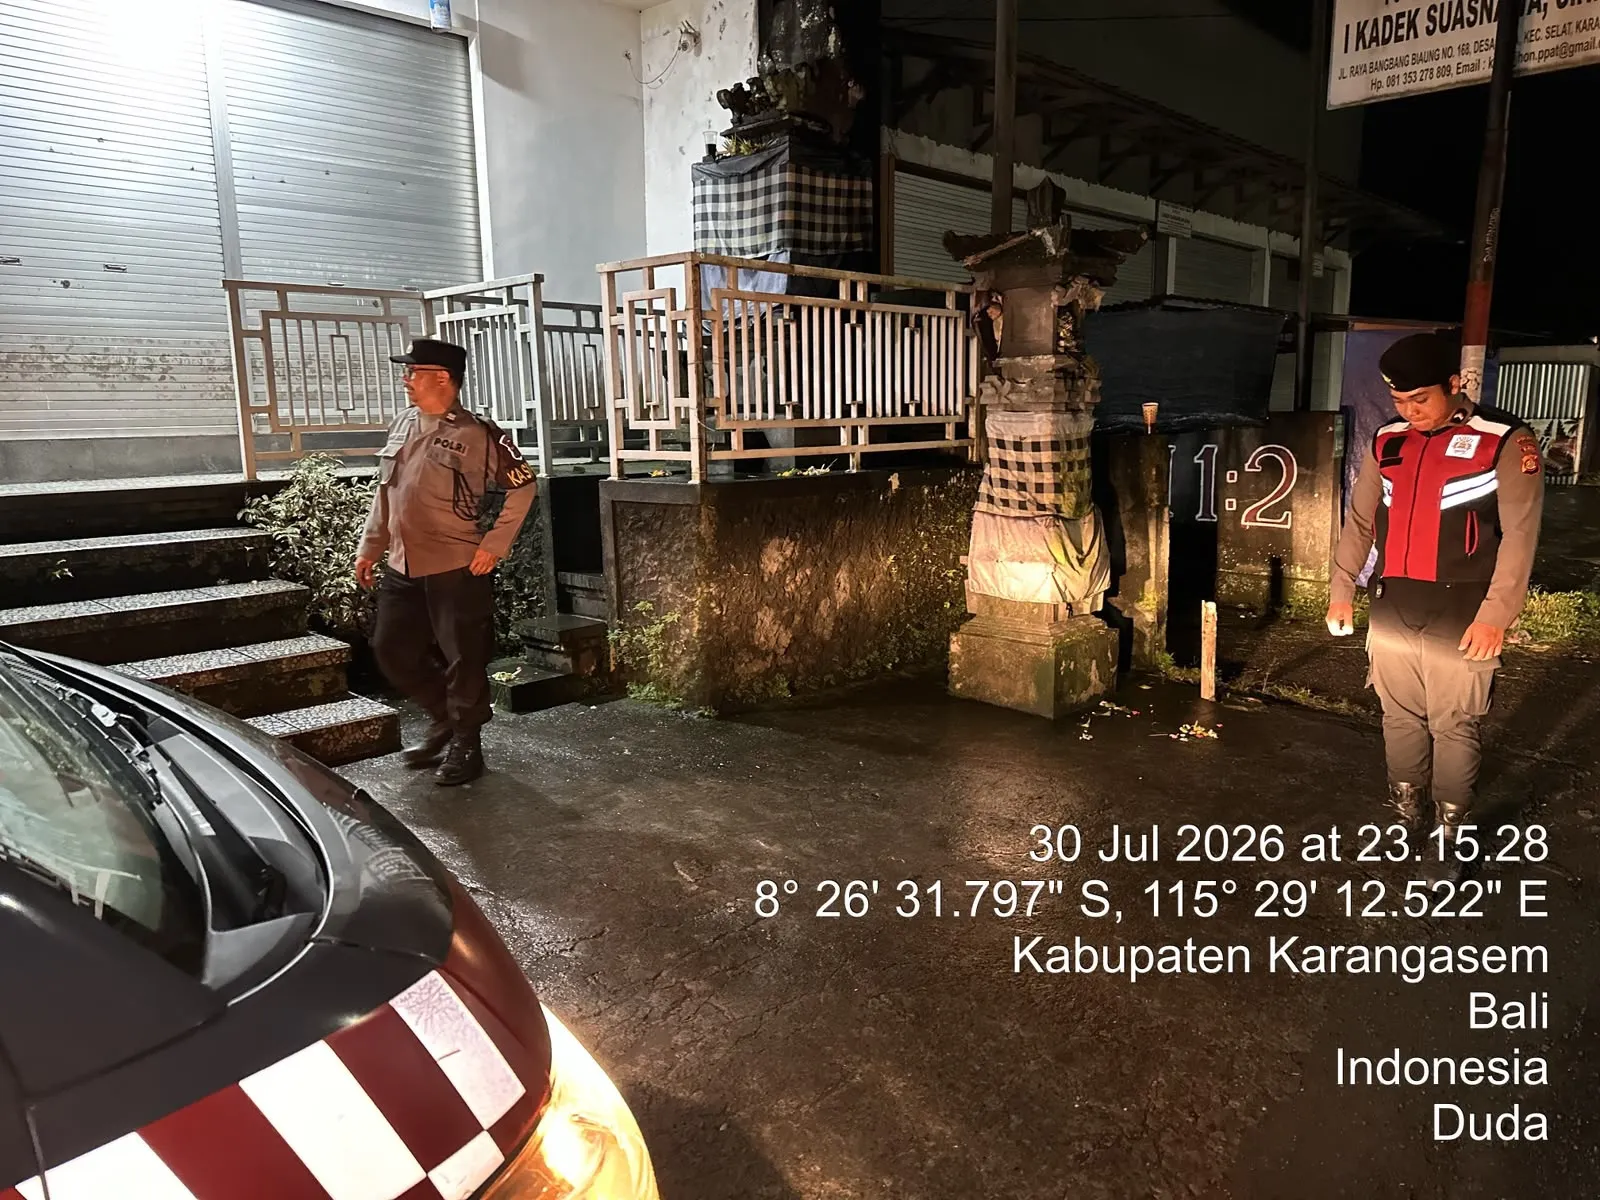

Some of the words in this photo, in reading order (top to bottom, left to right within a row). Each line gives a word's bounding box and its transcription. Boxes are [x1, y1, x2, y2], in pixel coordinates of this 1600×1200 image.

[1343, 24, 1350, 54] I
[1355, 7, 1421, 52] KADEK
[1349, 63, 1368, 79] RAYA
[1368, 54, 1410, 74] BANGBANG
[1441, 45, 1455, 60] NO.
[1473, 37, 1495, 54] DESA
[1523, 28, 1543, 44] KEC.
[1370, 78, 1384, 92] Hp.
[1386, 74, 1400, 88] 081
[1402, 70, 1418, 85] 353
[1419, 67, 1434, 82] 278
[1456, 58, 1481, 75] Email
[433, 437, 467, 454] POLRI
